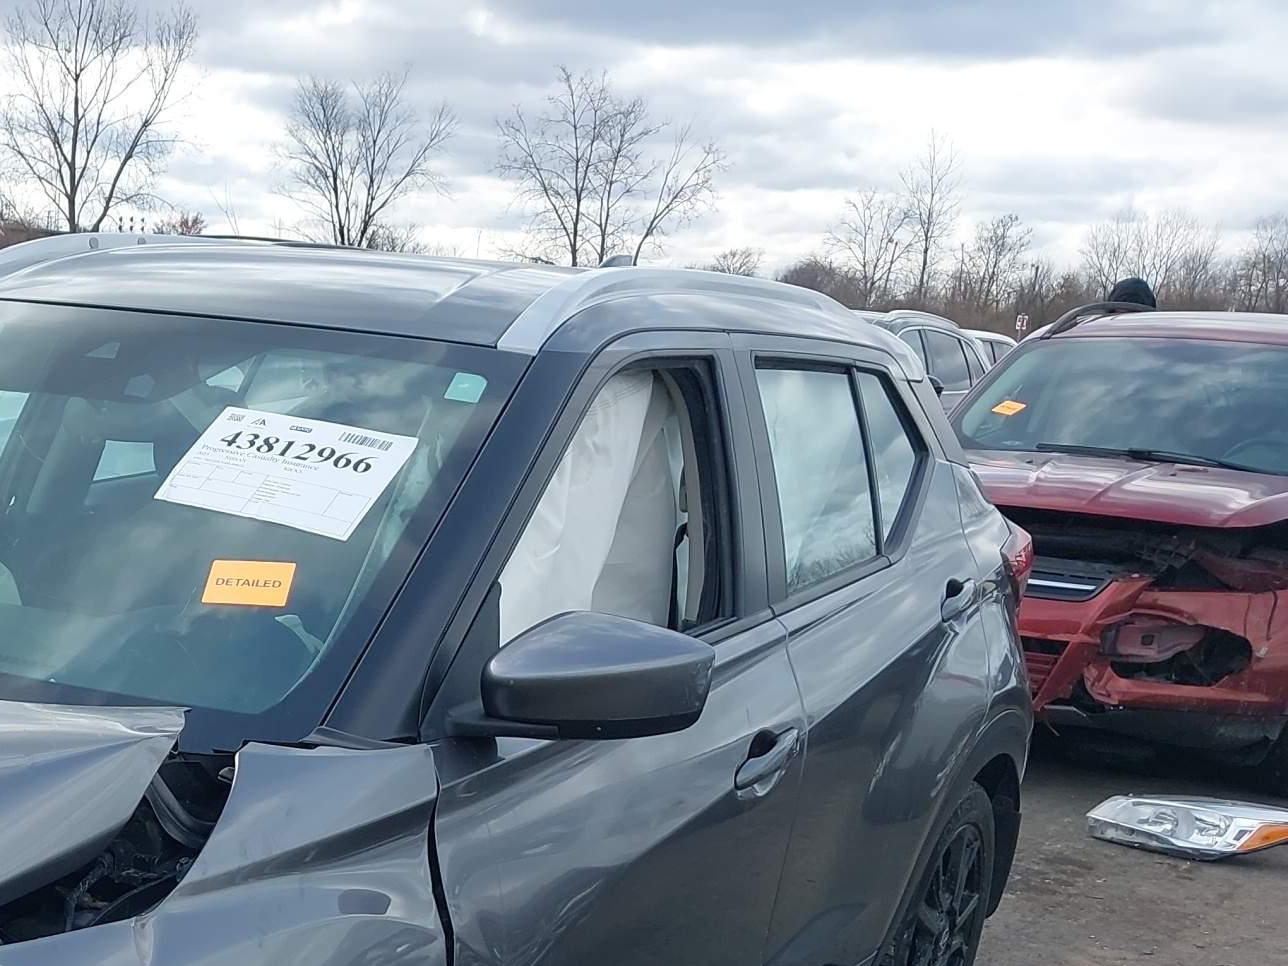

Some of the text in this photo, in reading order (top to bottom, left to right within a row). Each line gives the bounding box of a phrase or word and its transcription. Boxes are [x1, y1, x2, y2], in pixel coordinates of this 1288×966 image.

[220, 430, 379, 474] 43812966
[281, 458, 320, 471] Insurance
[215, 577, 282, 588] DETAILED
